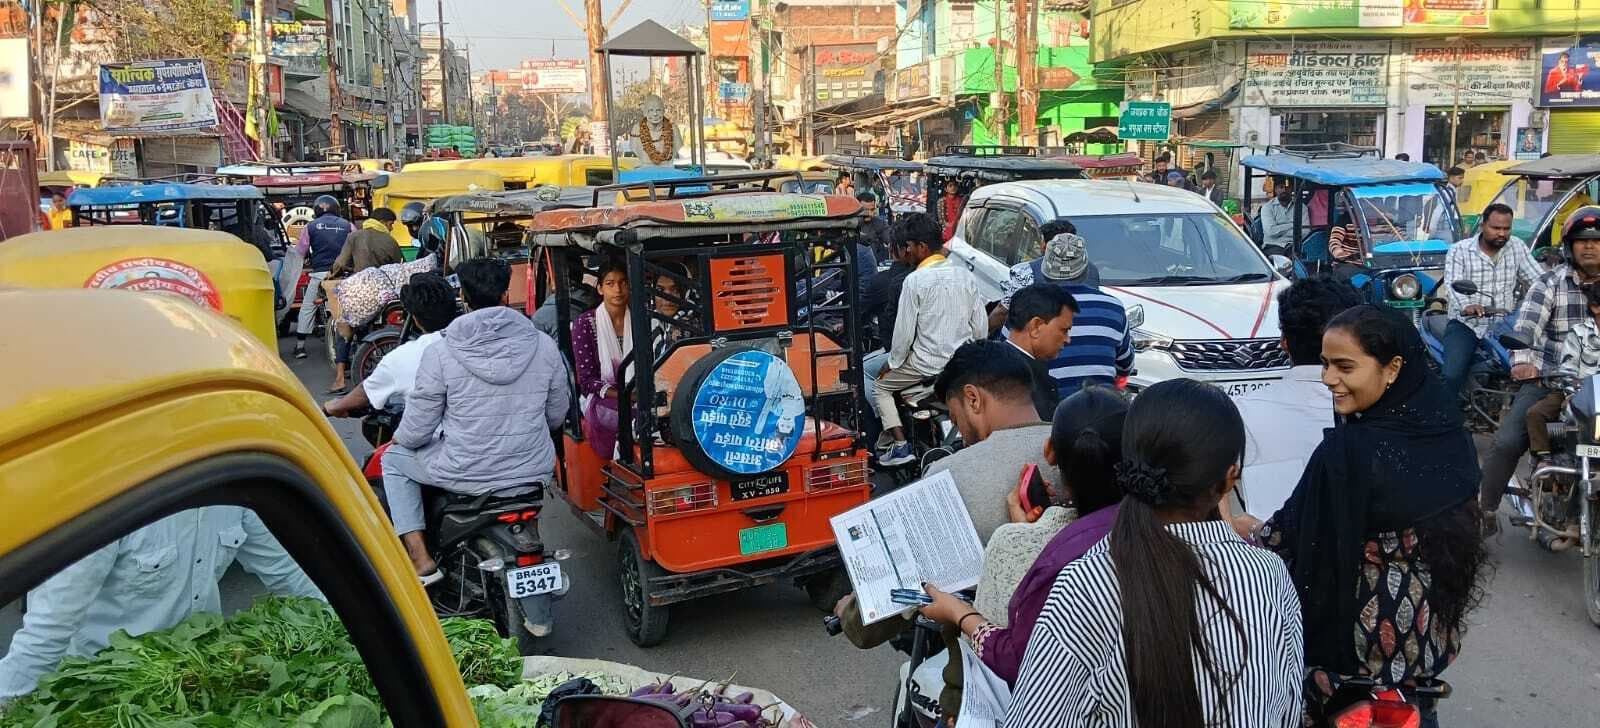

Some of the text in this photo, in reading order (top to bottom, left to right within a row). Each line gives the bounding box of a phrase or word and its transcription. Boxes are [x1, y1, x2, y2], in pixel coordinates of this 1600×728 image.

[710, 394, 747, 409] DURO
[713, 433, 743, 448] पाईप
[724, 451, 762, 465] असली
[1587, 448, 1600, 456] BR
[738, 476, 782, 489] CITY LIFE
[516, 567, 551, 580] BR45Q
[516, 576, 556, 595] 5347
